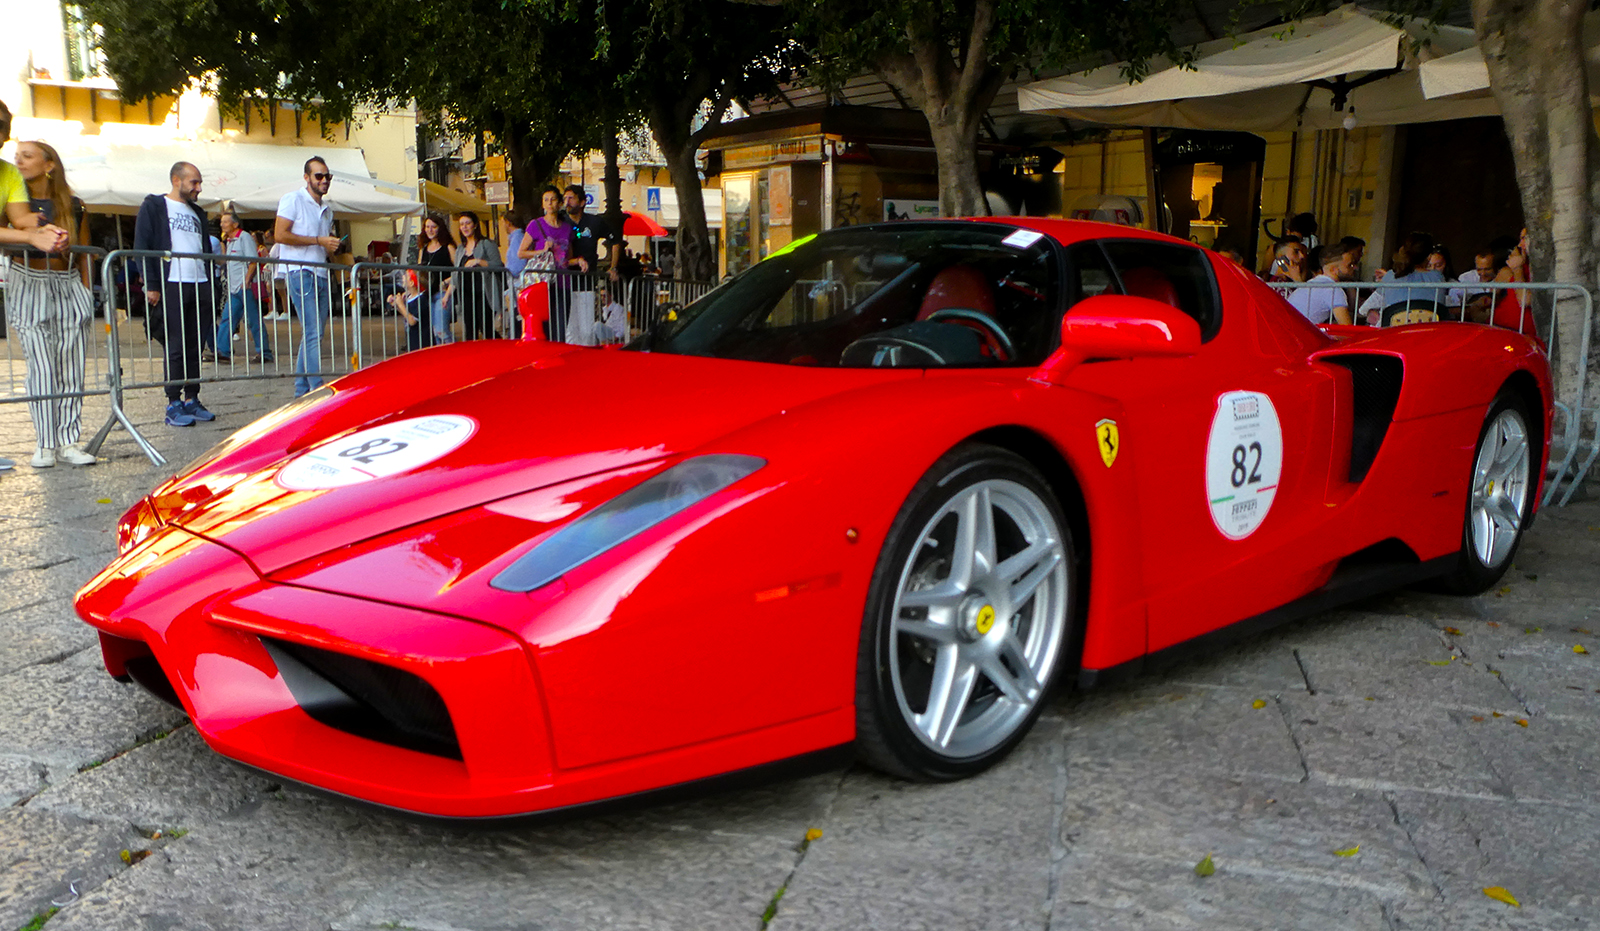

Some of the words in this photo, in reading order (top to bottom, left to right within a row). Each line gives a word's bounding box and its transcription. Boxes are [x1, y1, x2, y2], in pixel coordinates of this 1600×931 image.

[169, 217, 193, 226] ORTH
[171, 222, 193, 232] FACE
[338, 438, 409, 464] 82
[1230, 441, 1262, 488] 82
